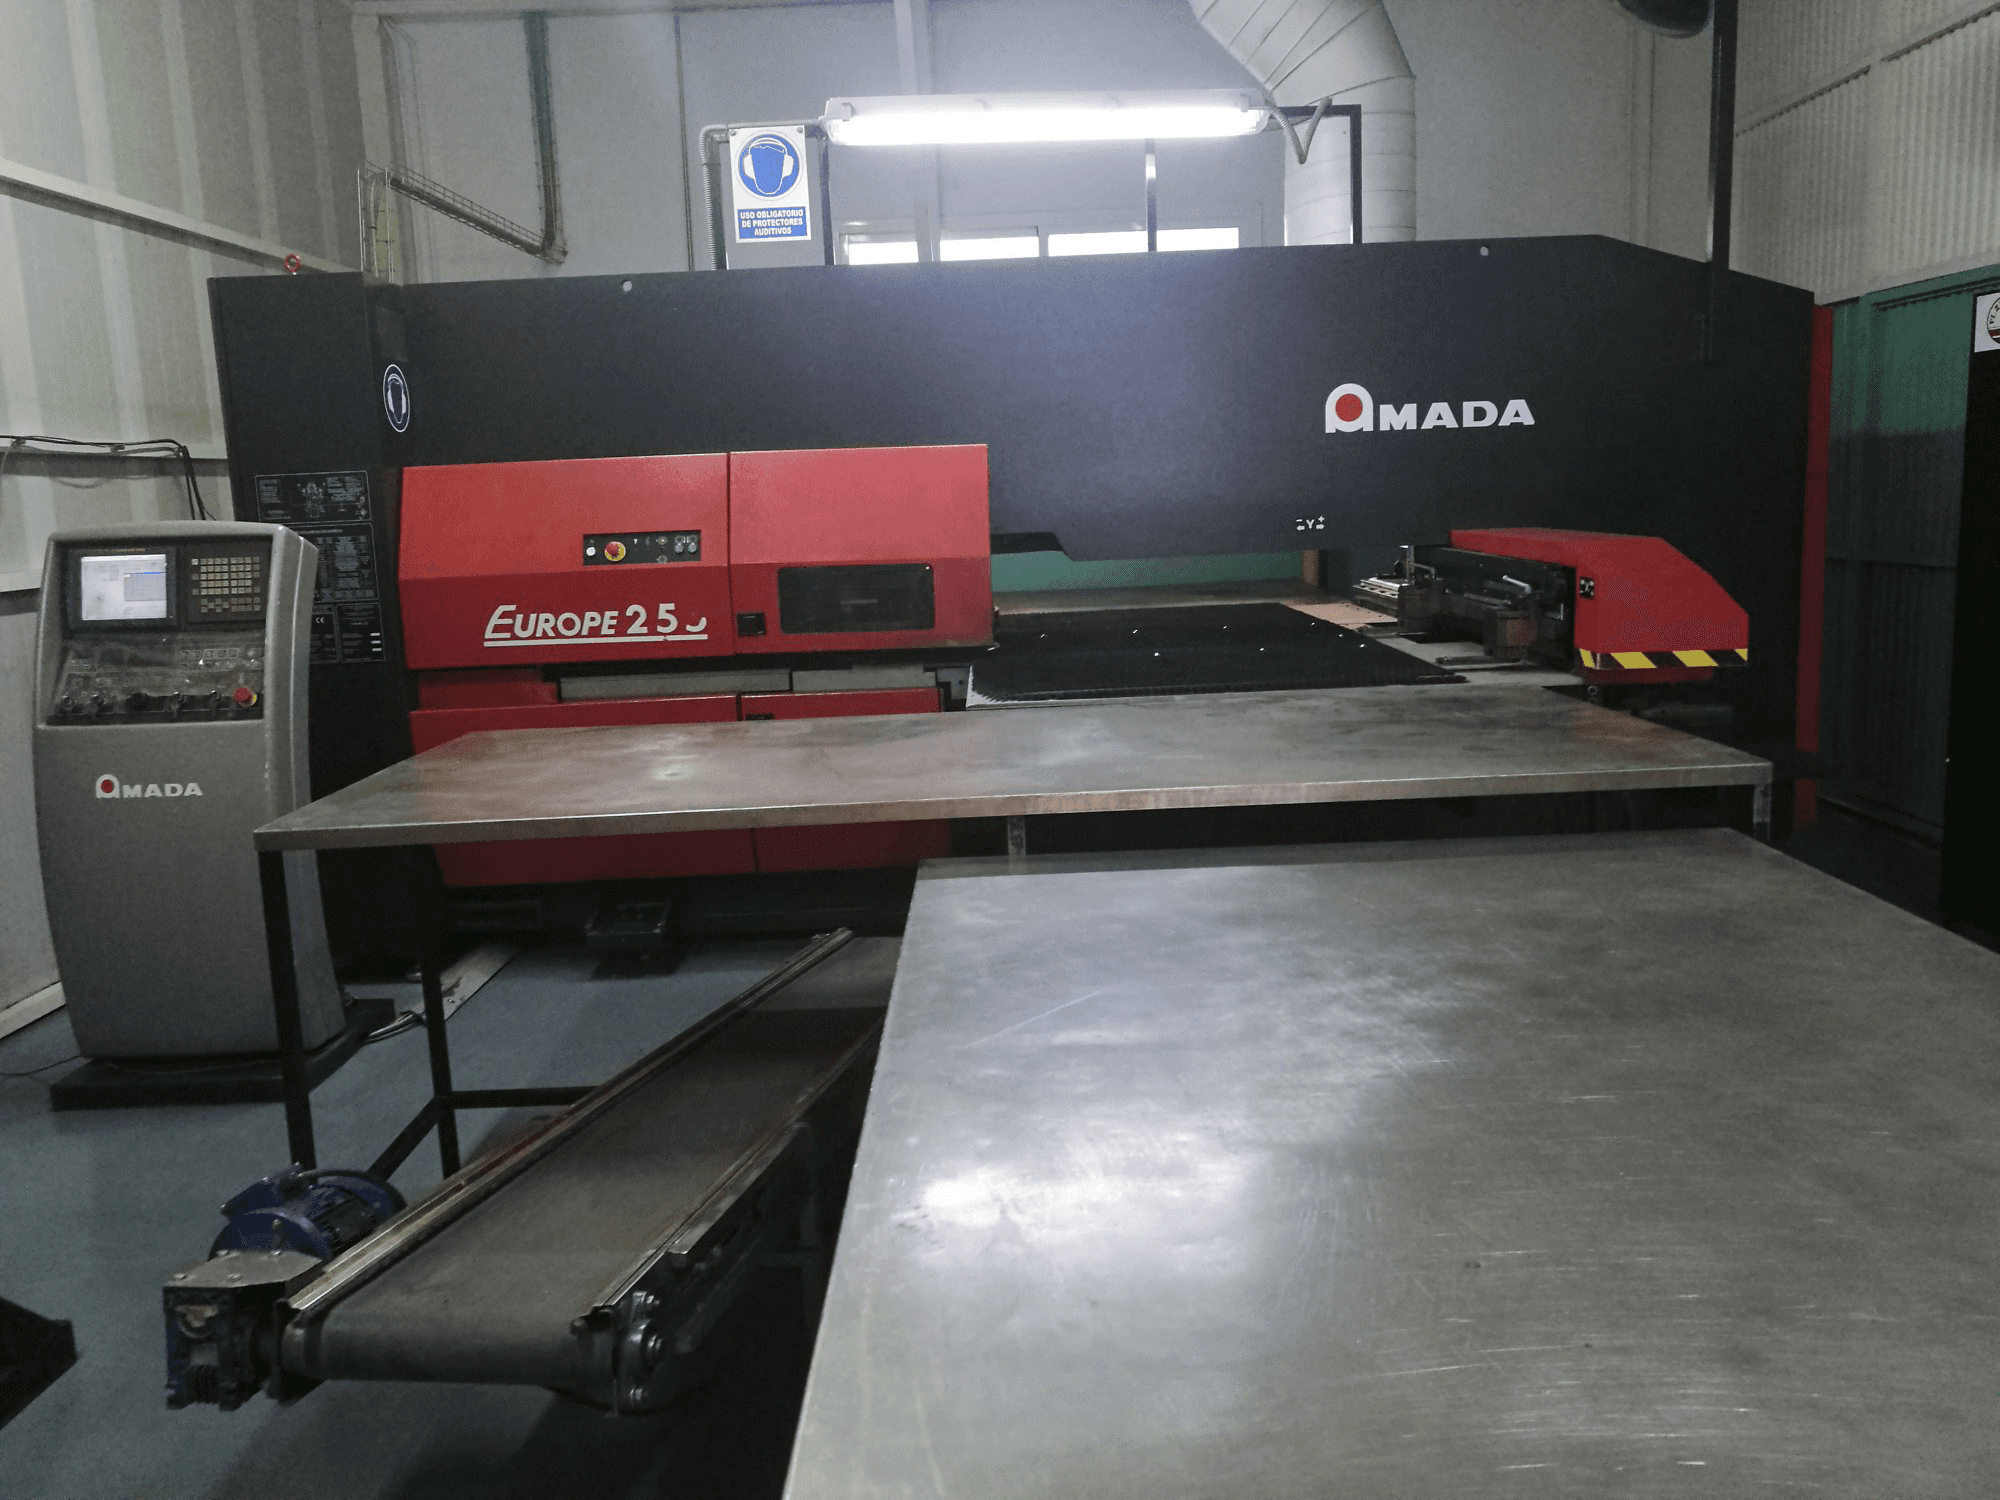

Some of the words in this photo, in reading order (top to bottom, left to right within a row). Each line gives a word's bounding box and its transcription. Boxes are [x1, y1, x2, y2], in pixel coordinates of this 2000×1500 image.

[740, 211, 755, 219] USO
[756, 209, 804, 219] OBLIGATORIO
[741, 220, 751, 228] DE
[752, 217, 803, 227] PROTECTORES
[754, 226, 792, 236] AUDITIVOS
[1325, 383, 1535, 433] AMADA
[95, 773, 204, 799] AMADA
